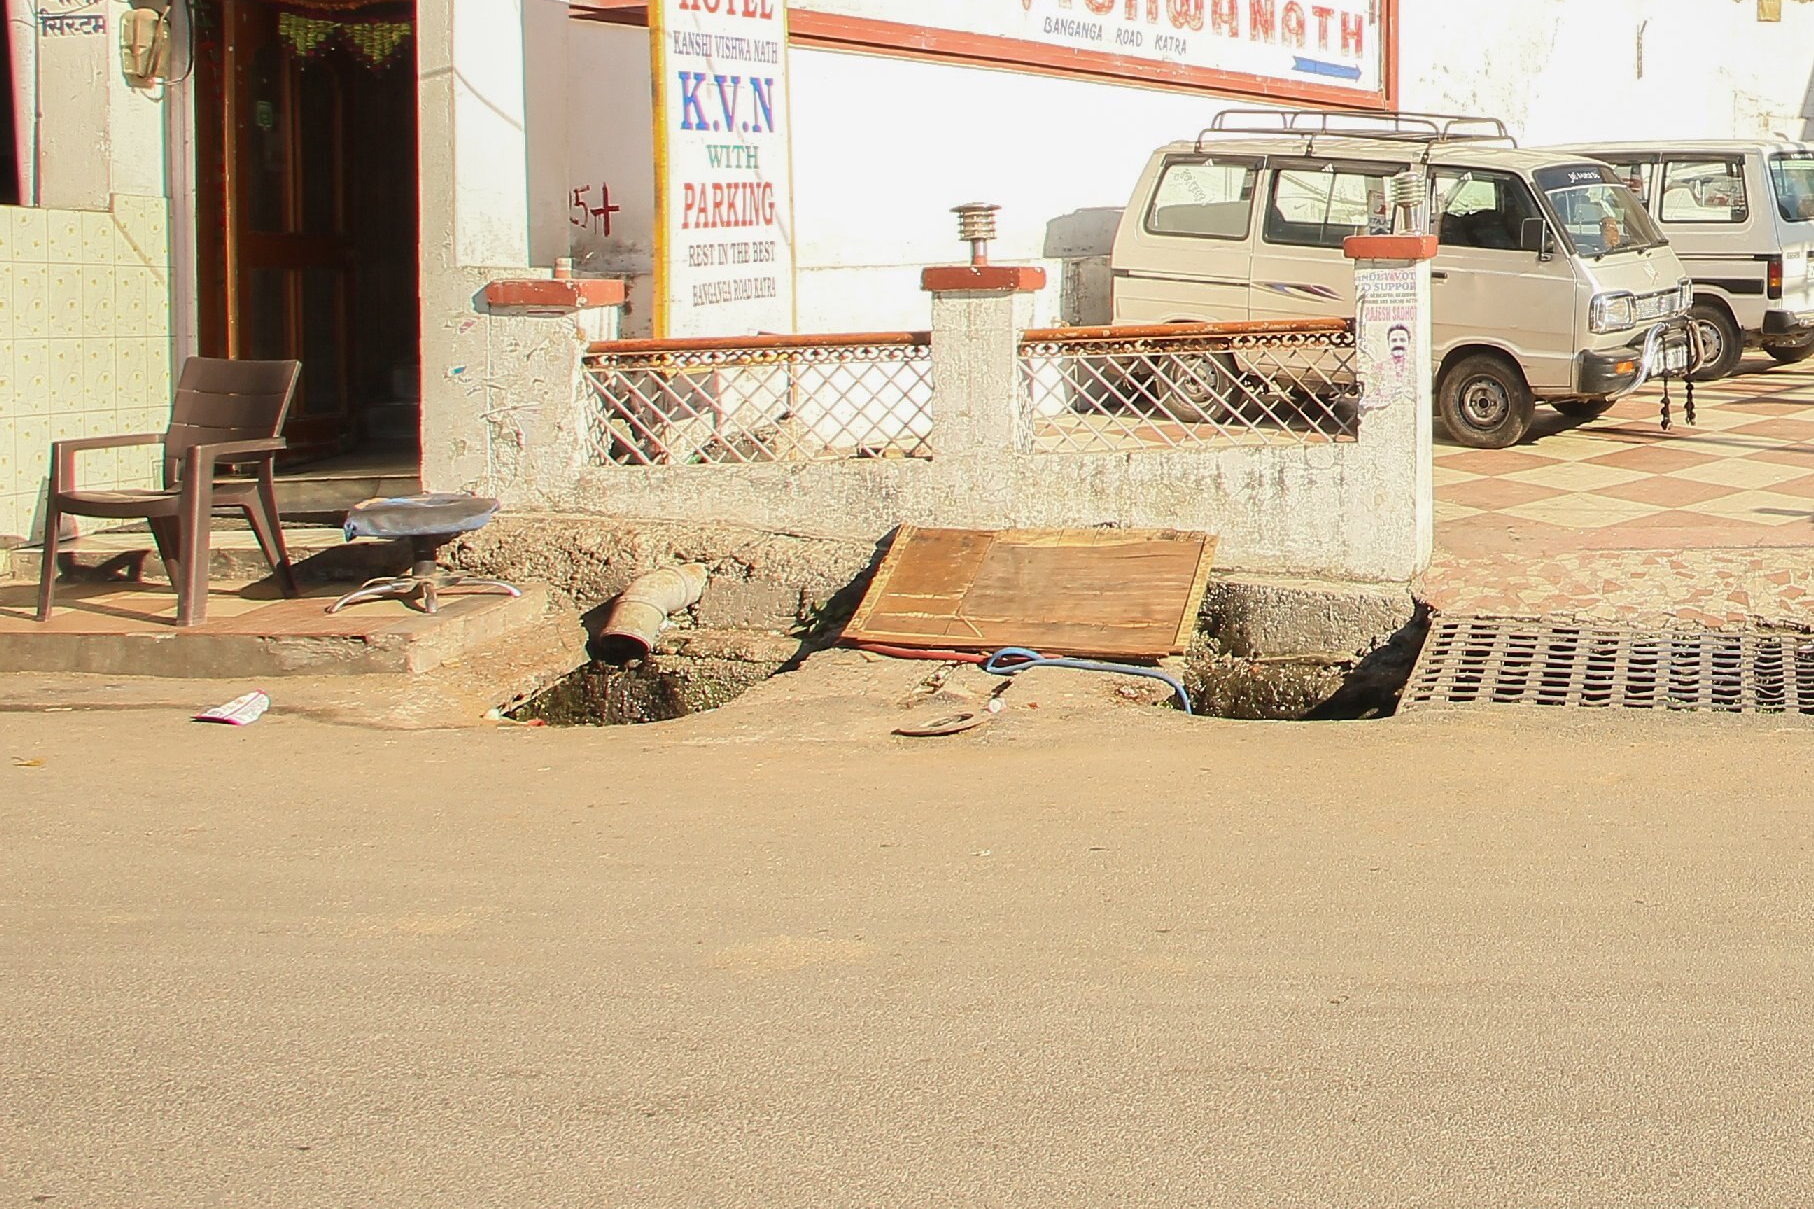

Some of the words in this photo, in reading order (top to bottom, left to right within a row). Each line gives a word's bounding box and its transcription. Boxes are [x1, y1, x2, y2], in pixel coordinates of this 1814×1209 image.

[673, 30, 713, 58] KANSHI
[714, 35, 752, 62] VISHWA
[753, 40, 778, 64] NATH
[1043, 16, 1103, 42] BANGANGA
[1115, 27, 1143, 47] ROAD
[1154, 33, 1187, 56] KATRA
[678, 70, 775, 133] K.V.N
[706, 144, 759, 170] WITH
[681, 181, 775, 230] PARKING
[688, 244, 716, 268] REST
[717, 243, 729, 266] IN
[730, 242, 751, 265] THE
[752, 240, 776, 264] BEST
